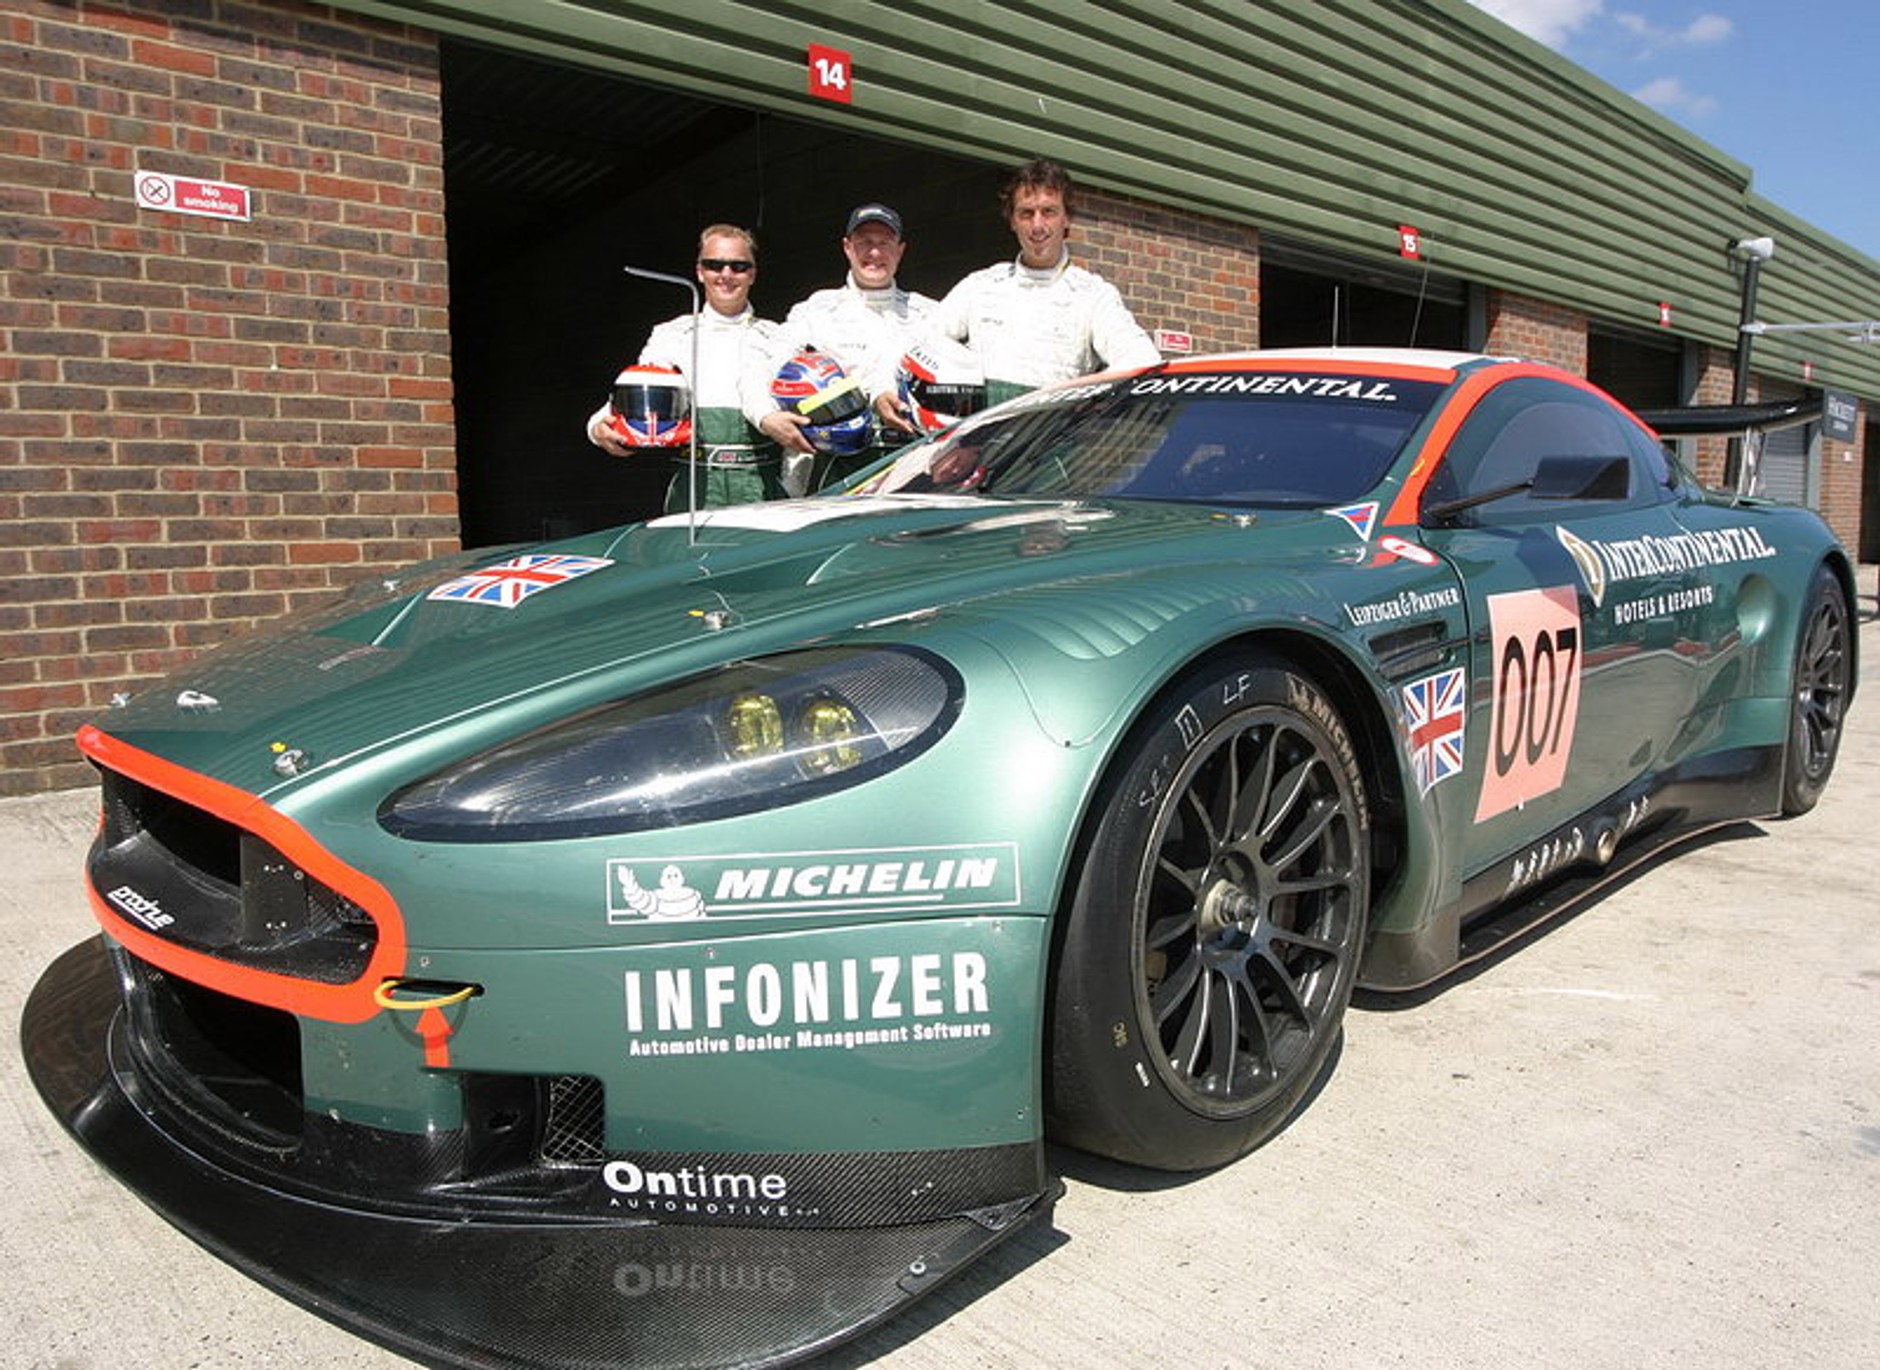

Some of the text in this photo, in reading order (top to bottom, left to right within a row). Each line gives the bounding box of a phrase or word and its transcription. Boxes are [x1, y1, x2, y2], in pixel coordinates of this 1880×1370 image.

[815, 58, 846, 90] 14
[183, 197, 239, 213] smoking
[201, 186, 221, 197] No
[1614, 597, 1656, 626] HOTELS
[1496, 627, 1577, 778] 007
[715, 858, 998, 901] MICHELIN
[625, 951, 990, 1033] INFONIZER
[629, 1021, 992, 1057] Automotive Dealer Management Software
[603, 1160, 787, 1200] Ontime
[610, 1198, 788, 1217] AUTOMOTIVE
